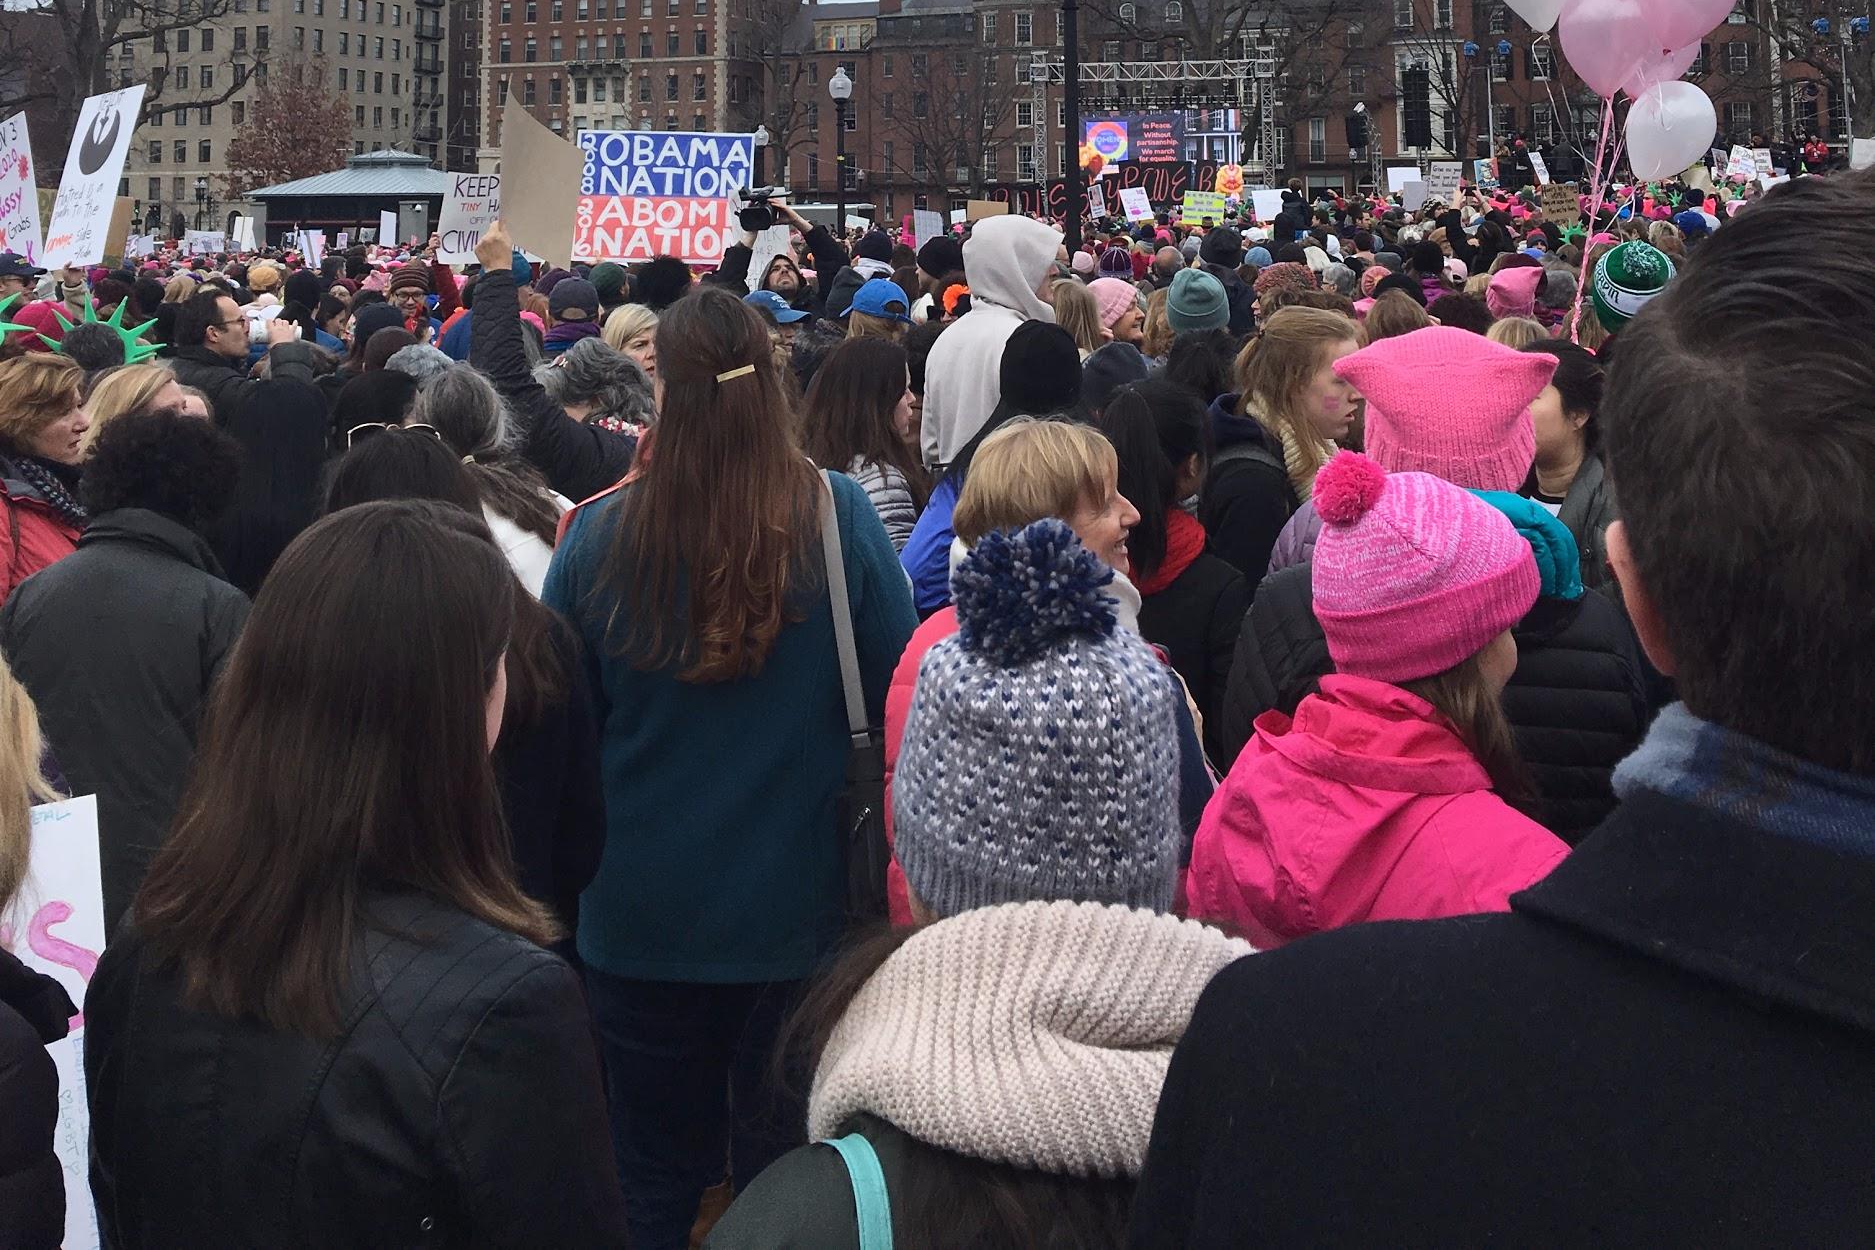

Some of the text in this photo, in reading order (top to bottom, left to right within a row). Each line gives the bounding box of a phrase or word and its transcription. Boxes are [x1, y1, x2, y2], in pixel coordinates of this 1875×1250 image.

[599, 133, 750, 169] OBAMA
[453, 174, 500, 198] KEEP
[598, 164, 747, 197] NATION
[461, 201, 482, 213] TINY
[7, 216, 32, 241] Grabs
